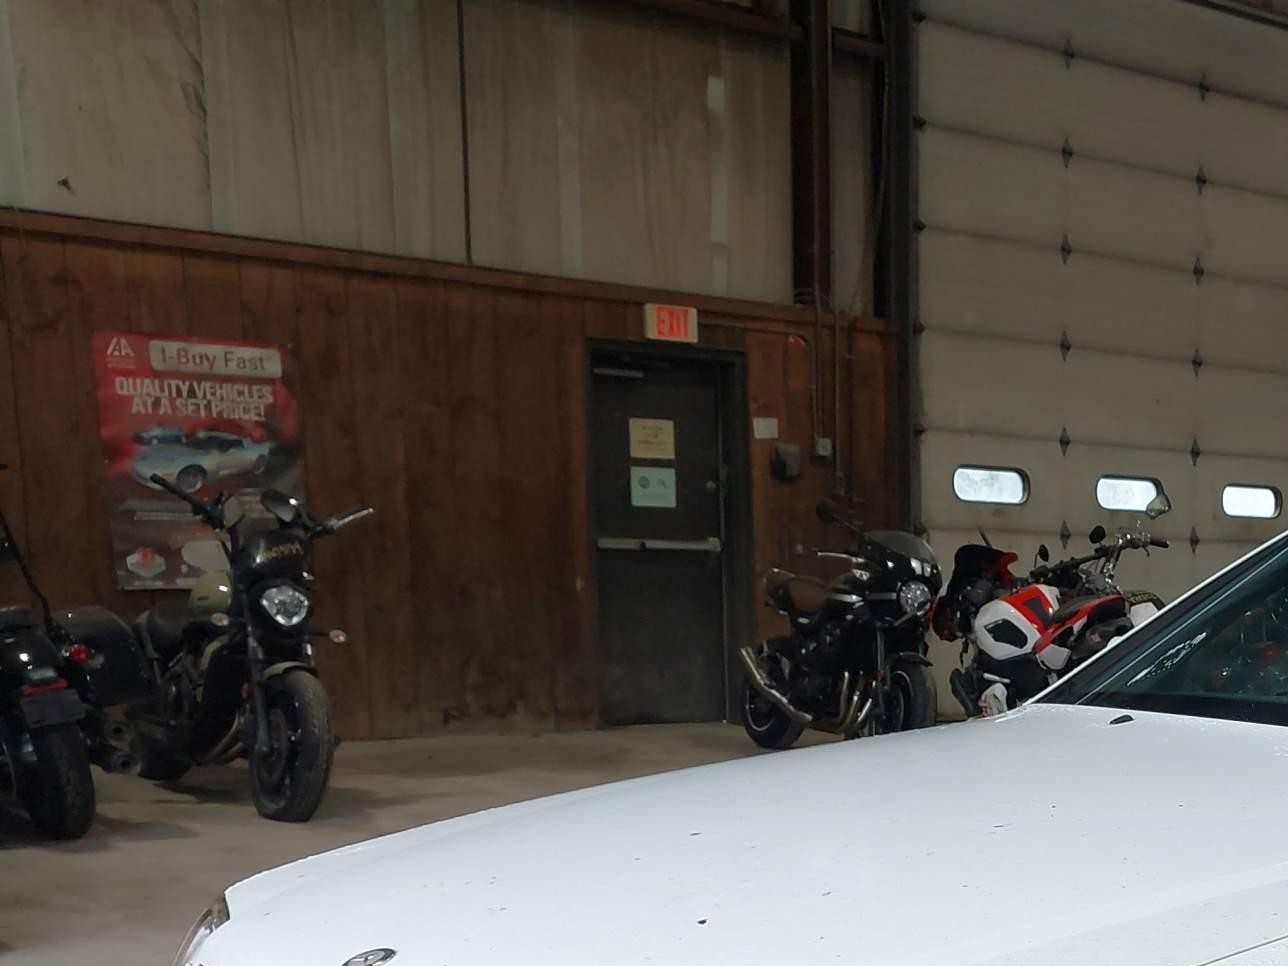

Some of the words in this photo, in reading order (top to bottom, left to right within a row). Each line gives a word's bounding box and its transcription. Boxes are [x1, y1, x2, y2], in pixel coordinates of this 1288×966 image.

[656, 307, 689, 338] EXIT
[161, 345, 217, 371] I-Buy
[114, 376, 190, 399] QUALITY
[192, 379, 273, 404] VEHICLES
[131, 396, 156, 415] AT
[159, 397, 172, 416] A
[176, 398, 208, 418] SET
[211, 400, 266, 421] PRICE!
